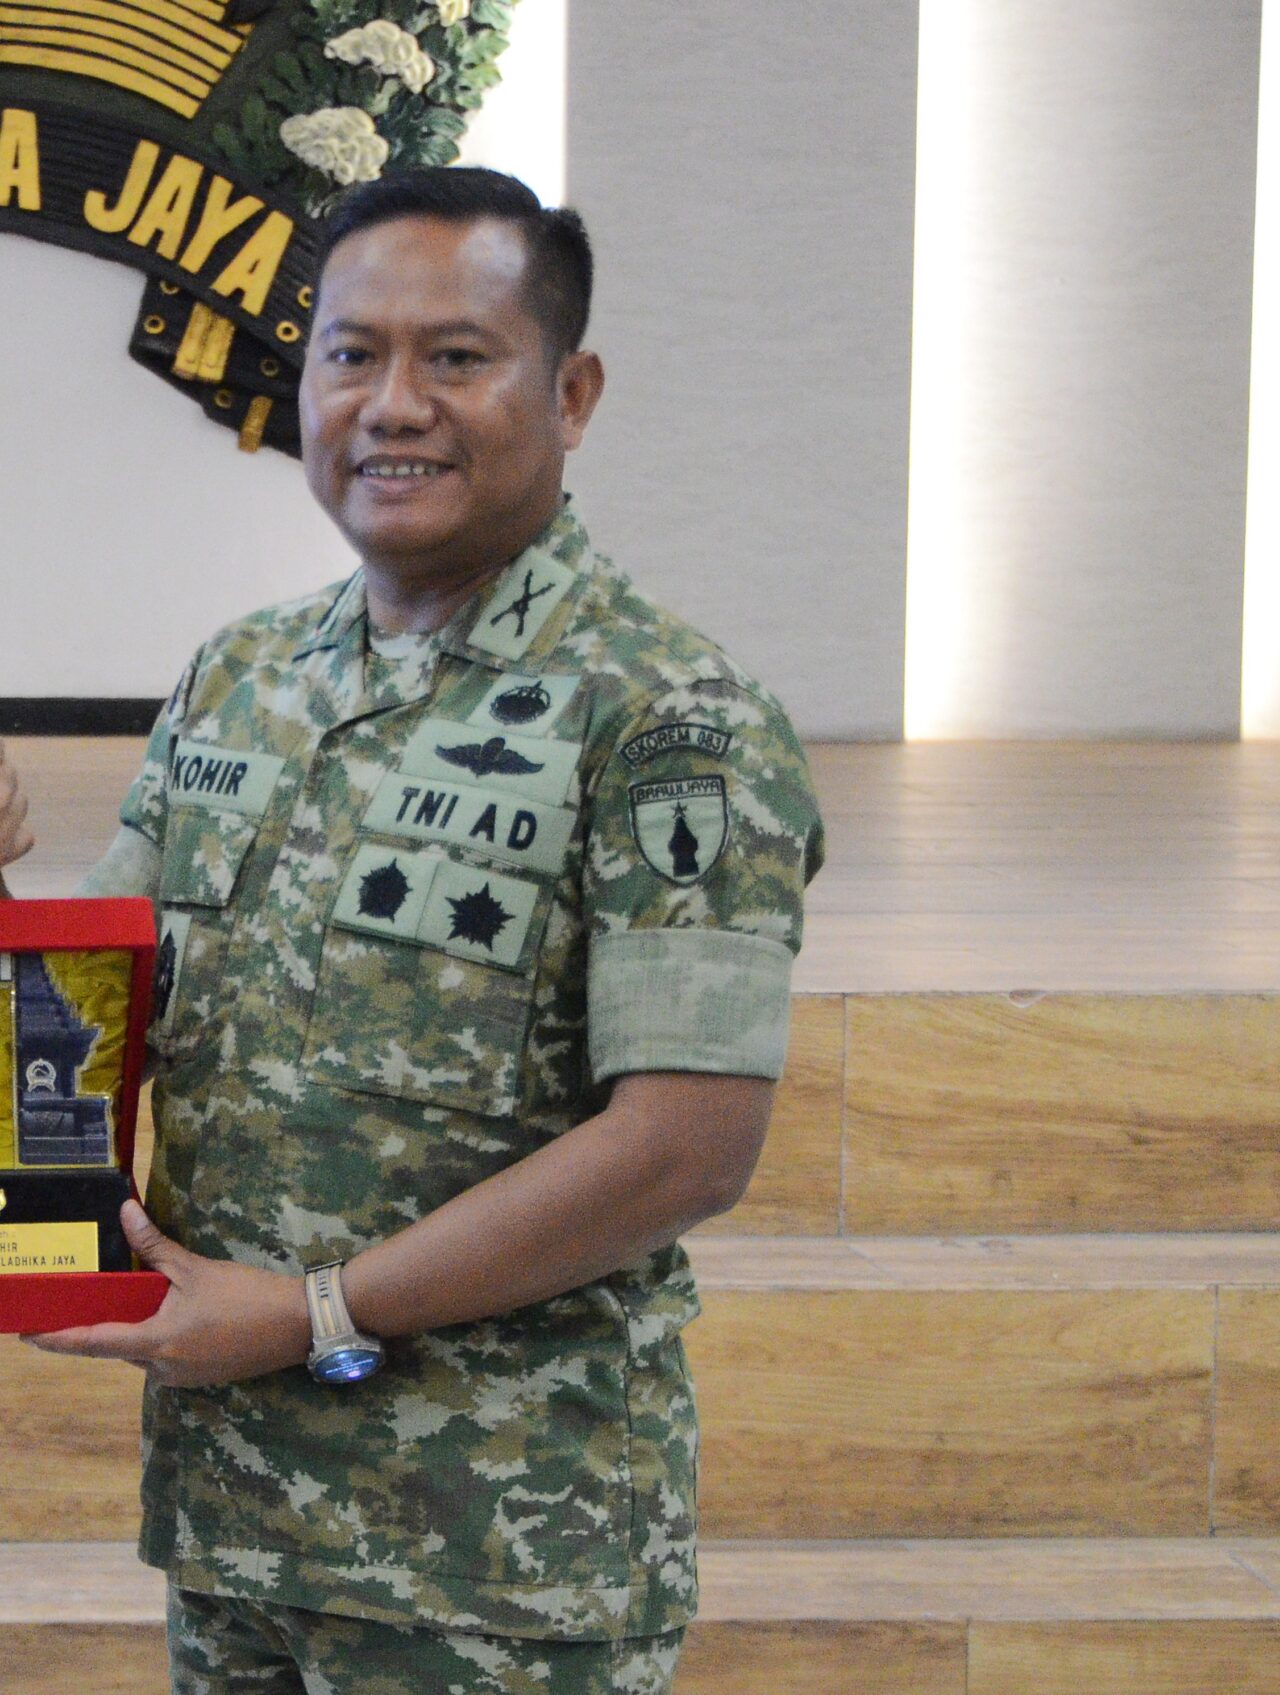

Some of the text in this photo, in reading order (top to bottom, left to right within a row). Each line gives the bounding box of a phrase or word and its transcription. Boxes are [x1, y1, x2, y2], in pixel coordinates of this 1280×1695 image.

[83, 139, 295, 316] JAYA
[697, 730, 721, 751] 083
[172, 755, 248, 796] KOHIR
[636, 780, 720, 801] BRAWIJAYA
[395, 786, 459, 830] TNI
[51, 1255, 76, 1266] JAYA
